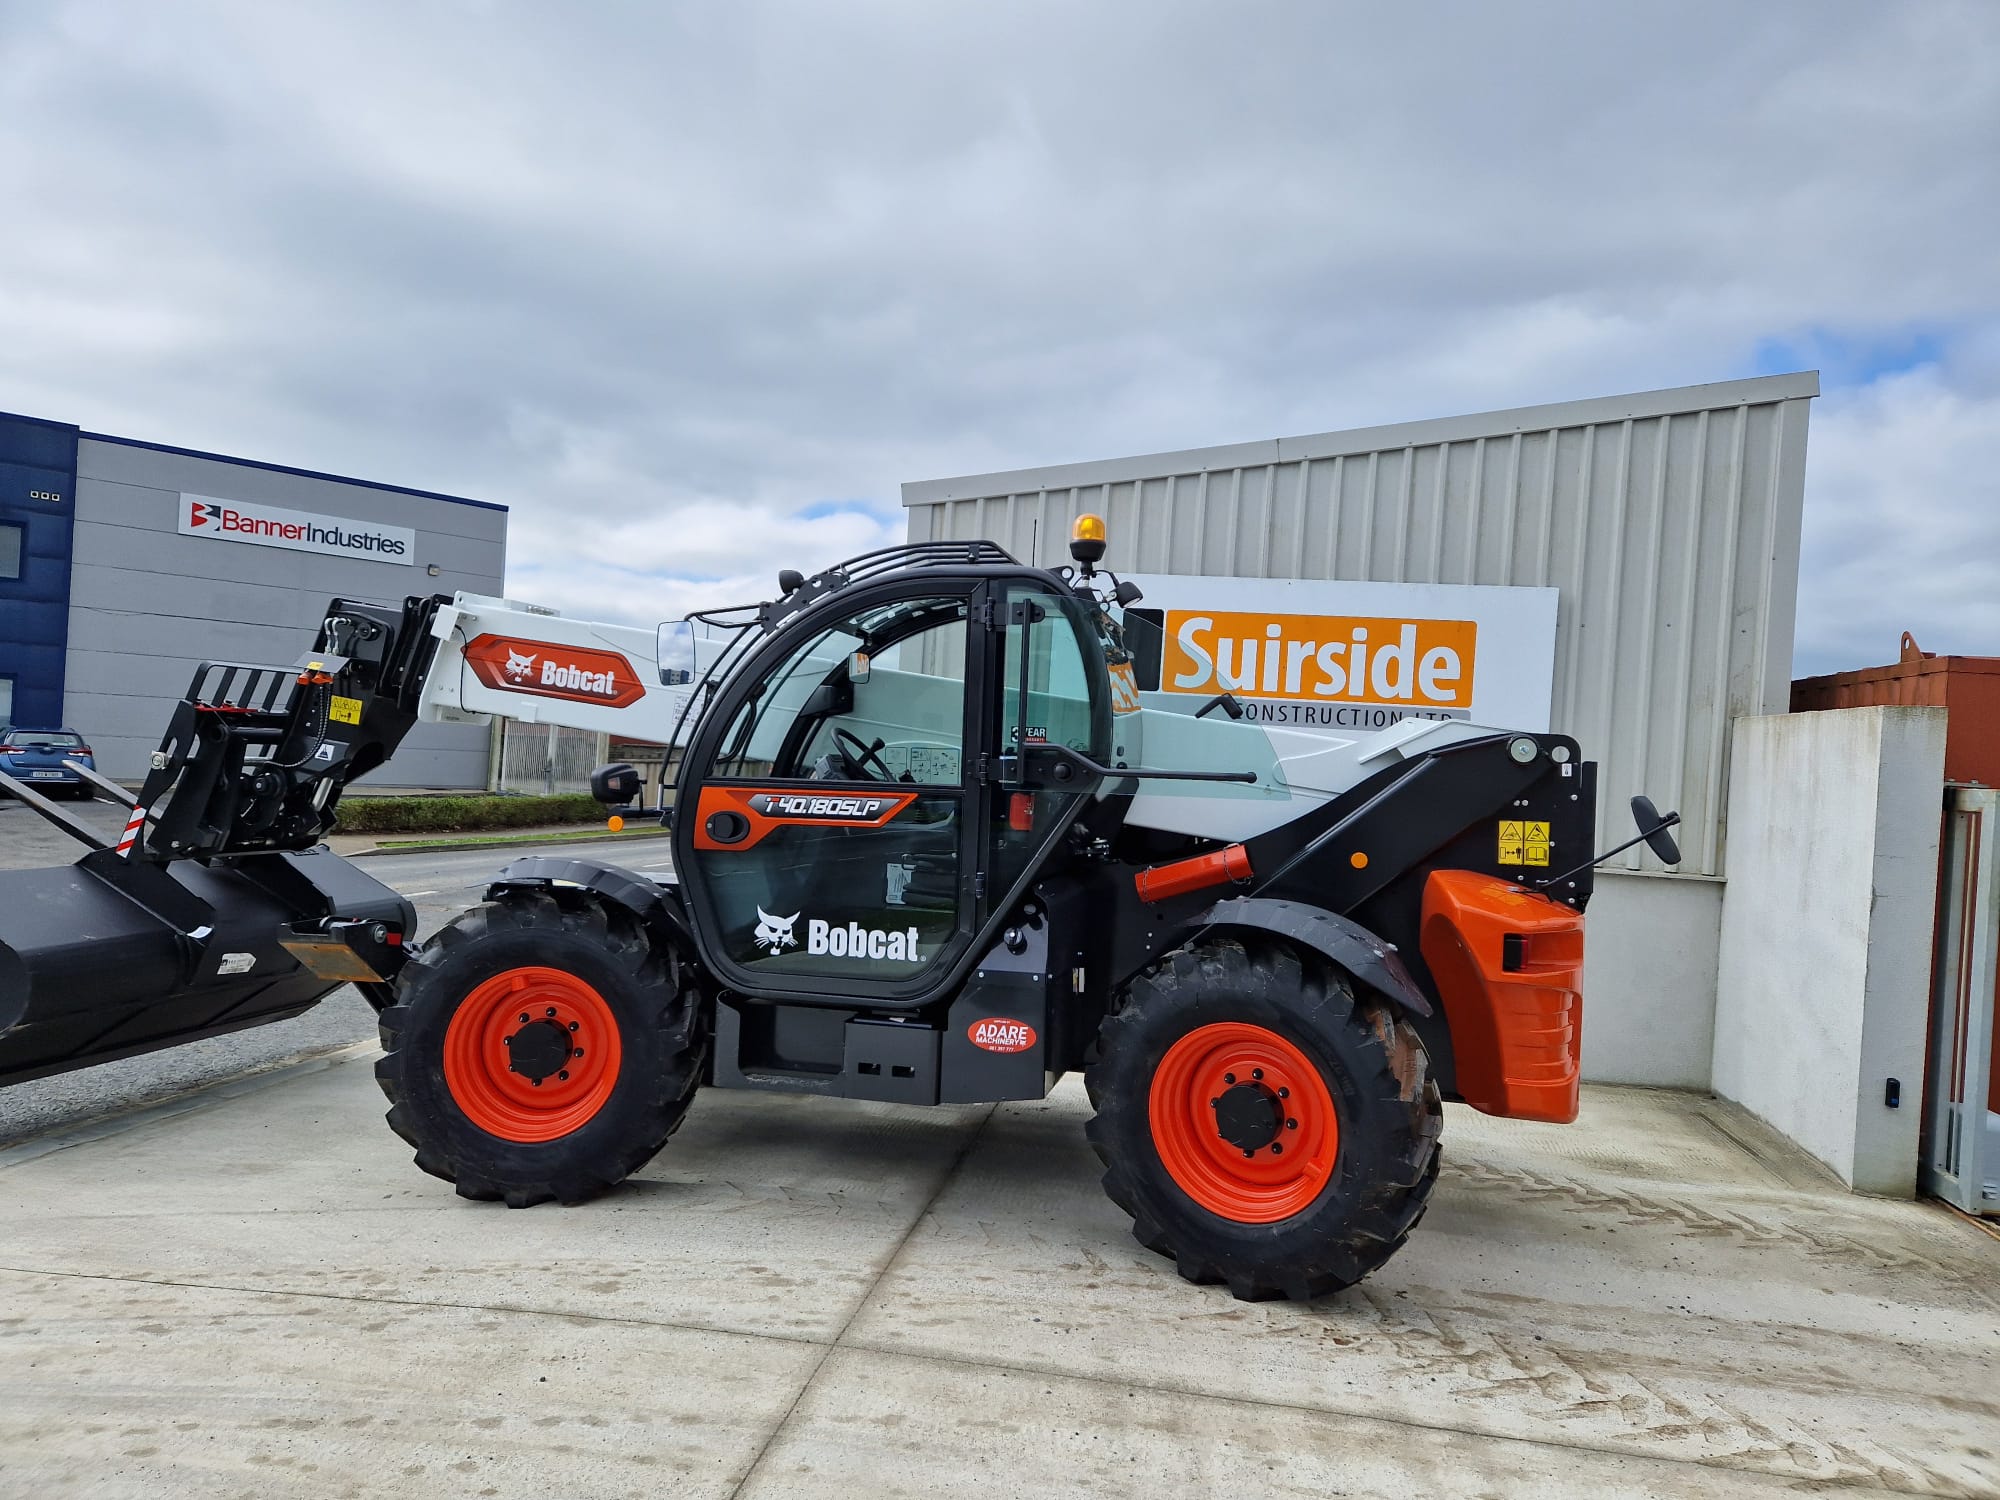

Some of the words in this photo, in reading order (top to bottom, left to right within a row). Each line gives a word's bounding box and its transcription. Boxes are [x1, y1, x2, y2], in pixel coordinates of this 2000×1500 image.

[1174, 616, 1461, 701] Suirside
[541, 660, 615, 695] Bobcat
[1238, 703, 1403, 728] ONSTRUCTION
[808, 919, 919, 962] Bobcat
[976, 1023, 1029, 1040] ADARE
[976, 1036, 1020, 1046] MACHINERY
